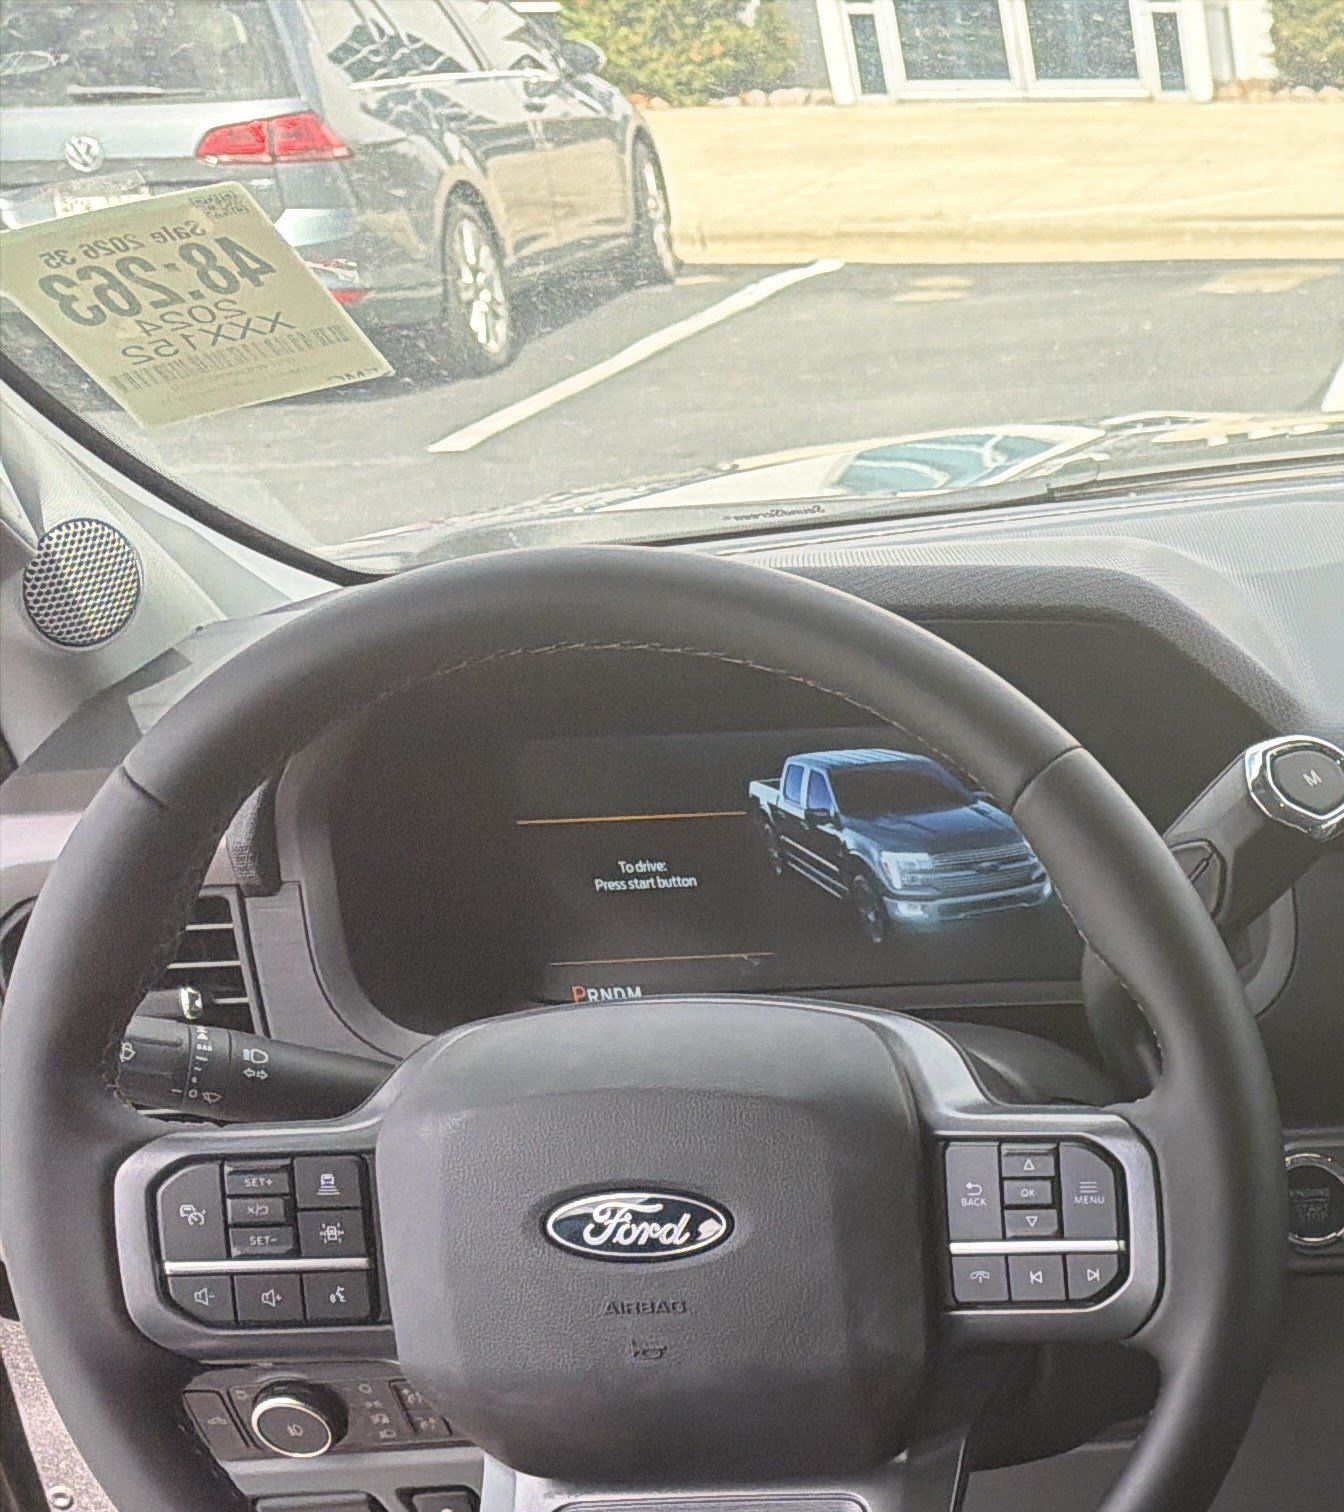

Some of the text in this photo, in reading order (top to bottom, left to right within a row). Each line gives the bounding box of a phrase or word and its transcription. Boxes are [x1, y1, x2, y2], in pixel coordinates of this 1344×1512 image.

[1301, 769, 1323, 788] M
[618, 859, 668, 873] To drive:
[594, 875, 698, 892] Press start button
[1020, 1188, 1036, 1198] OK
[1073, 1195, 1106, 1205] MENU
[960, 1197, 987, 1207] BACK
[582, 1201, 691, 1246] Ford
